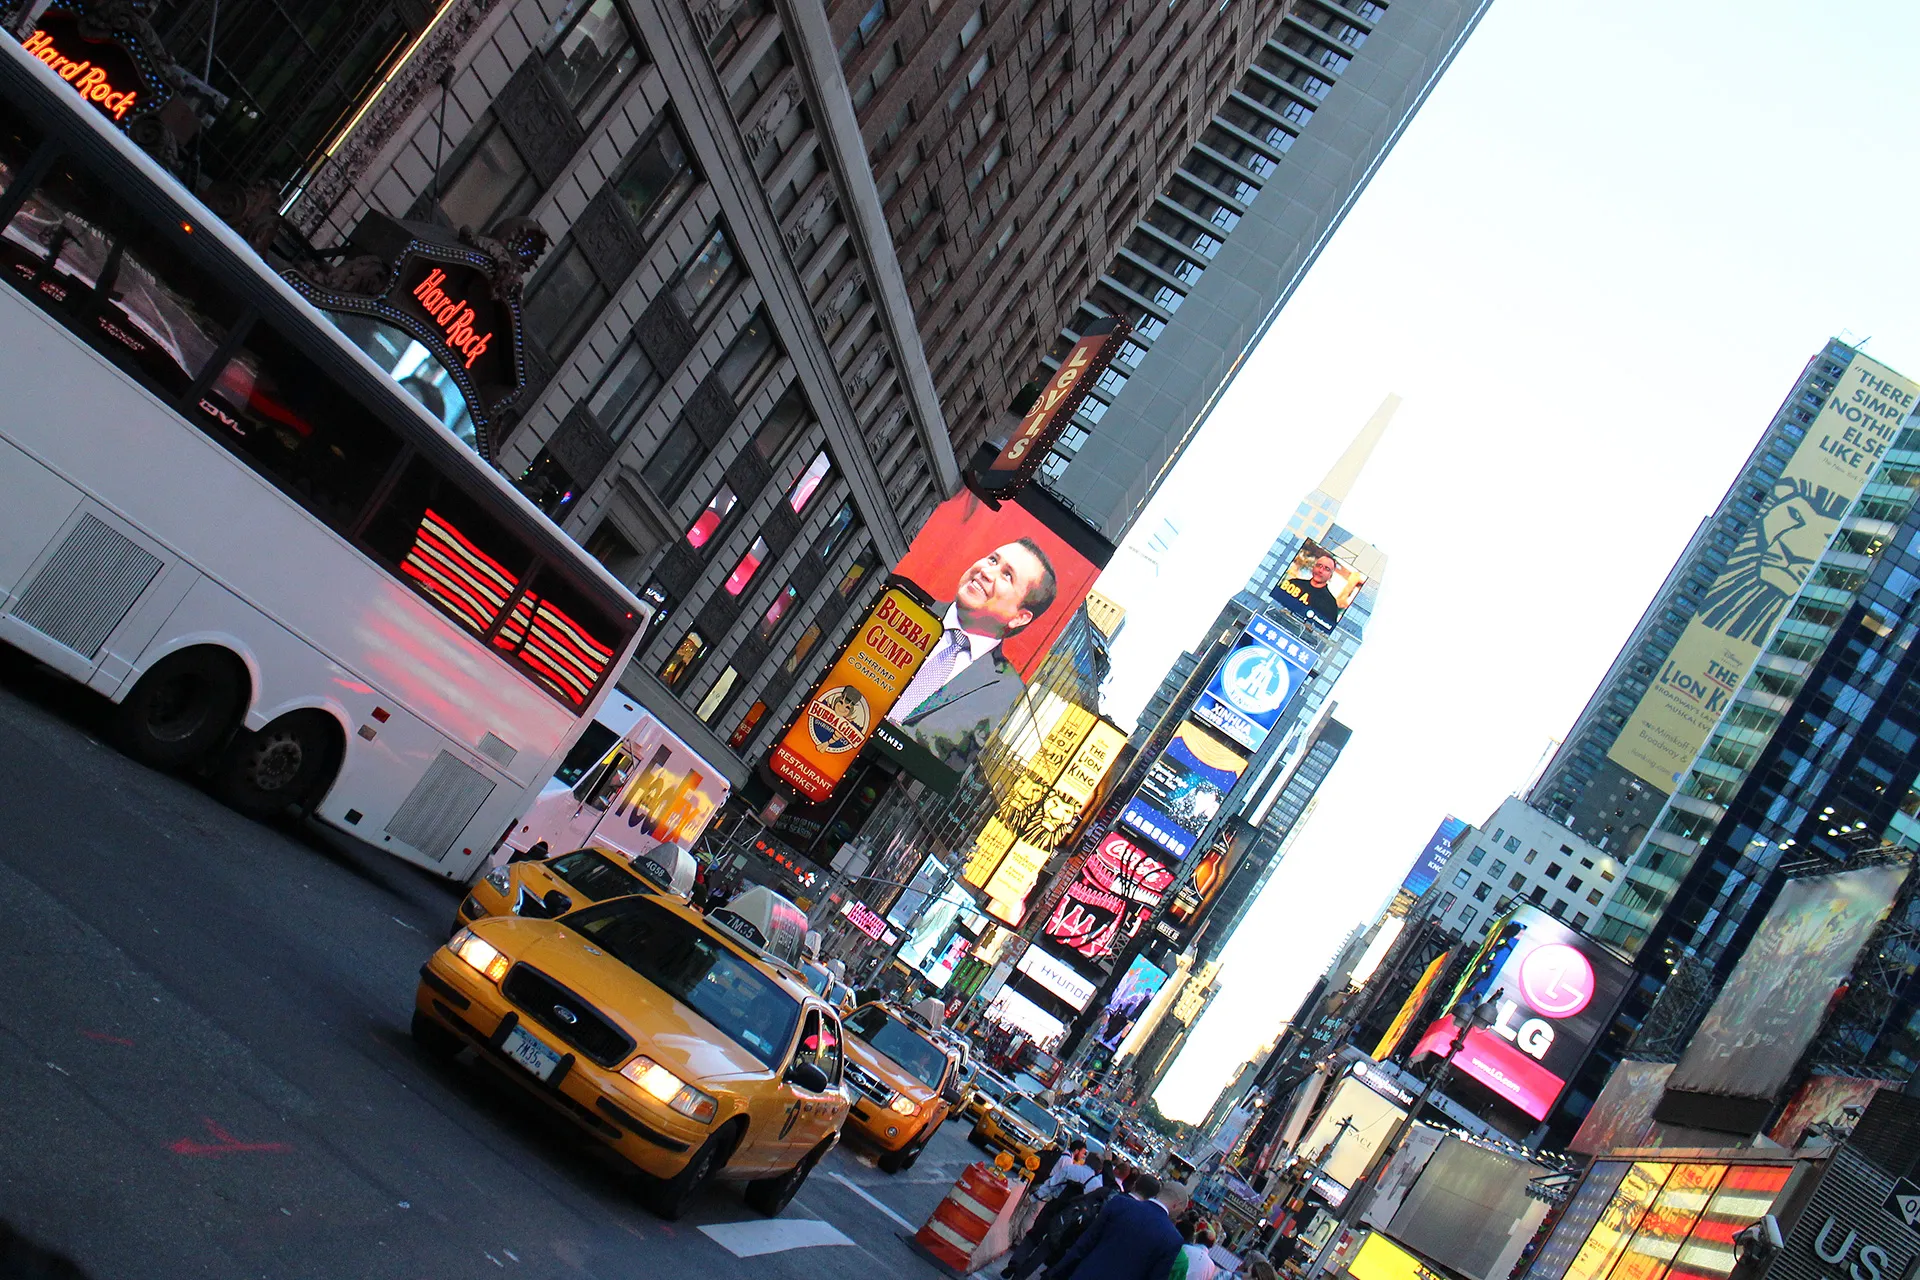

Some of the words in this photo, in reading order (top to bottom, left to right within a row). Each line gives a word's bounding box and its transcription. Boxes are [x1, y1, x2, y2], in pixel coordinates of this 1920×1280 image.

[21, 30, 90, 80] Hard
[76, 67, 136, 120] Rock
[413, 268, 467, 326] Hard
[446, 308, 493, 369] Rock
[1819, 435, 1864, 469] LIKE
[1842, 426, 1888, 459] ELSE
[1280, 580, 1302, 598] BOB
[1299, 594, 1309, 606] A.
[876, 596, 932, 652] BUBBA
[865, 624, 914, 670] GUMP
[847, 656, 894, 693] COMPANY
[858, 651, 896, 681] SHRIMP
[1659, 660, 1708, 699] LION
[1707, 659, 1740, 688] THE
[811, 702, 838, 727] BUBBA
[838, 719, 861, 746] GUMP
[814, 718, 835, 733] SHRIMP
[1198, 705, 1223, 728] NEWS
[1211, 702, 1252, 735] XINHUA
[1665, 703, 1698, 724] MUSICAL
[1089, 744, 1107, 760] THE
[1638, 729, 1680, 760] Broadway
[1655, 726, 1690, 750] Minskoff
[778, 748, 833, 791] RESTAURANT
[780, 764, 817, 793] MARKET
[1067, 764, 1096, 788] KING
[1078, 751, 1102, 773] LION
[615, 744, 704, 844] FedEx
[1125, 810, 1187, 857] SAMSUNG
[645, 859, 665, 879] 4G58
[1491, 1000, 1555, 1060] LG
[1472, 1057, 1520, 1093] www.LG.com
[1398, 1088, 1414, 1106] hut
